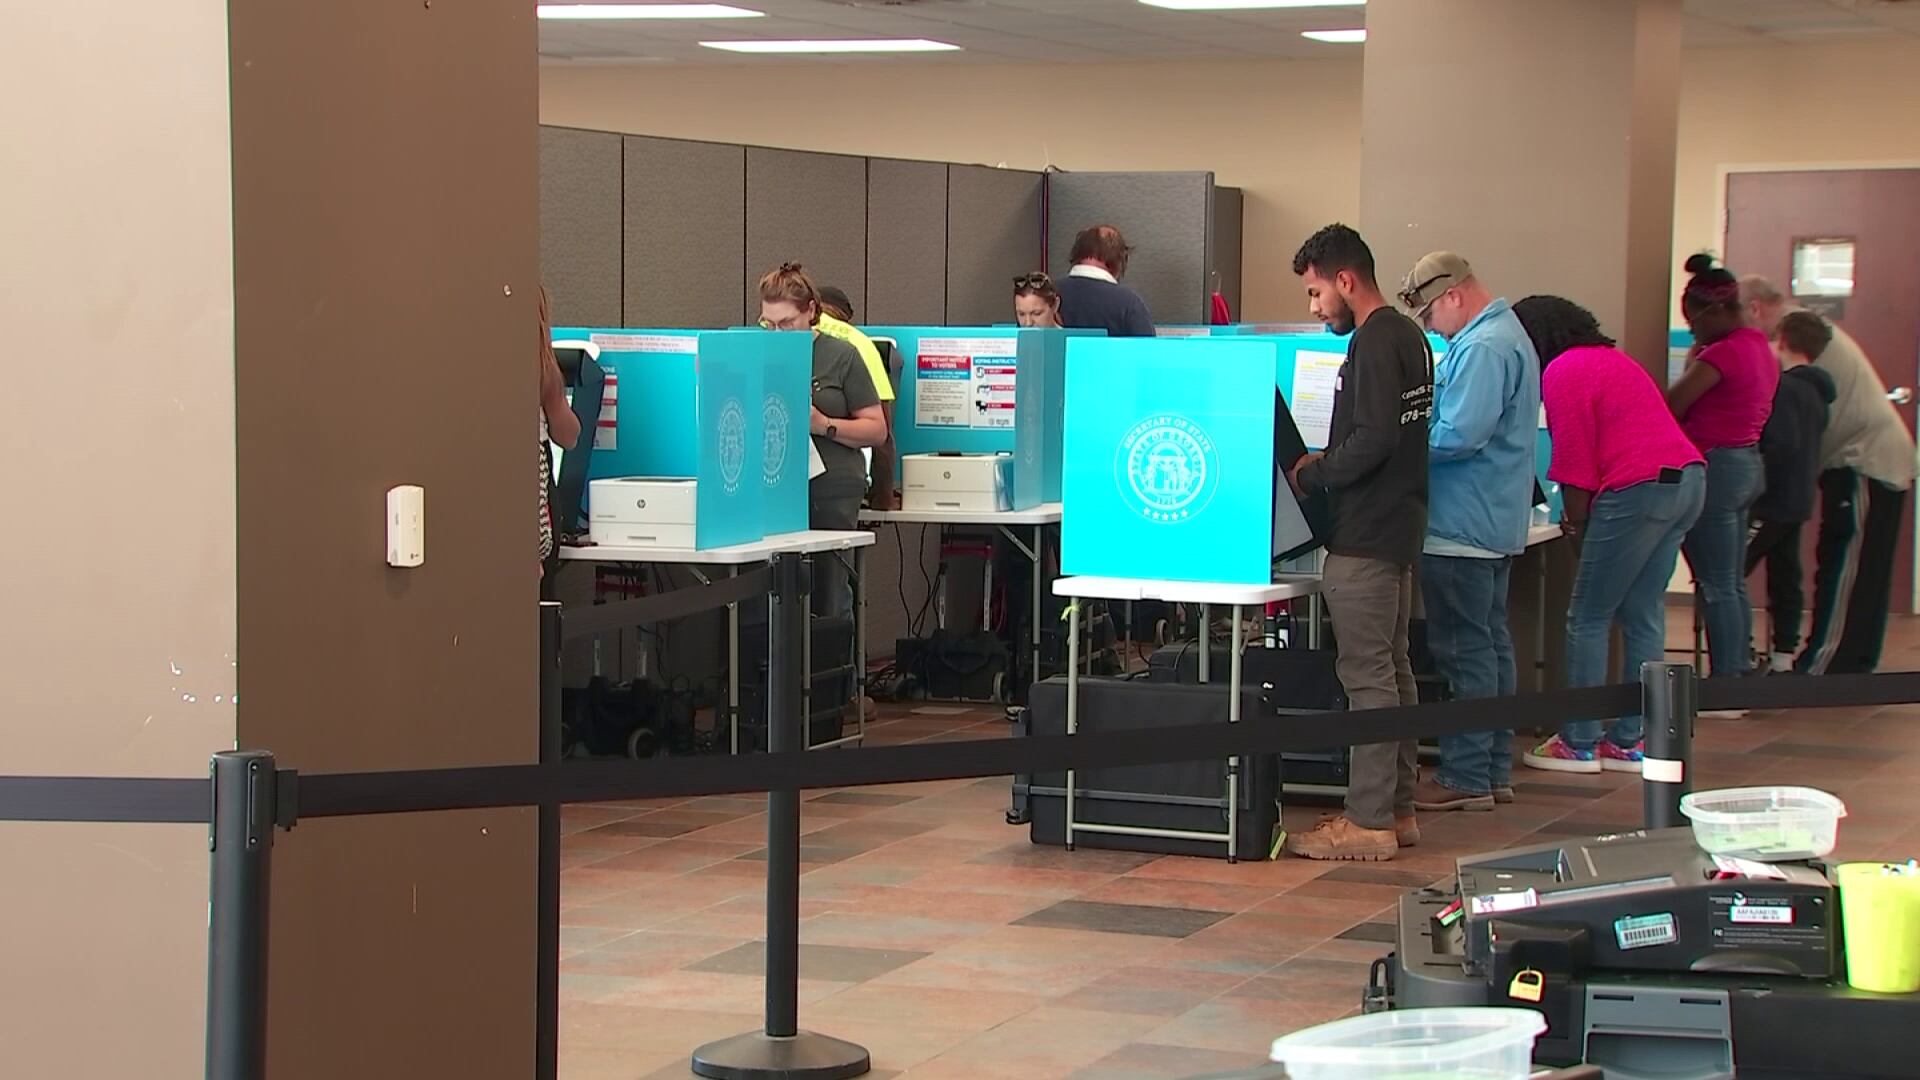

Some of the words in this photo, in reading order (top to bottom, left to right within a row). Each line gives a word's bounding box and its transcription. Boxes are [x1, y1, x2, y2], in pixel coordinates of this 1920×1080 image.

[1124, 416, 1172, 449] SECRETARY
[1173, 417, 1188, 428] OF
[1187, 424, 1212, 453] STATE
